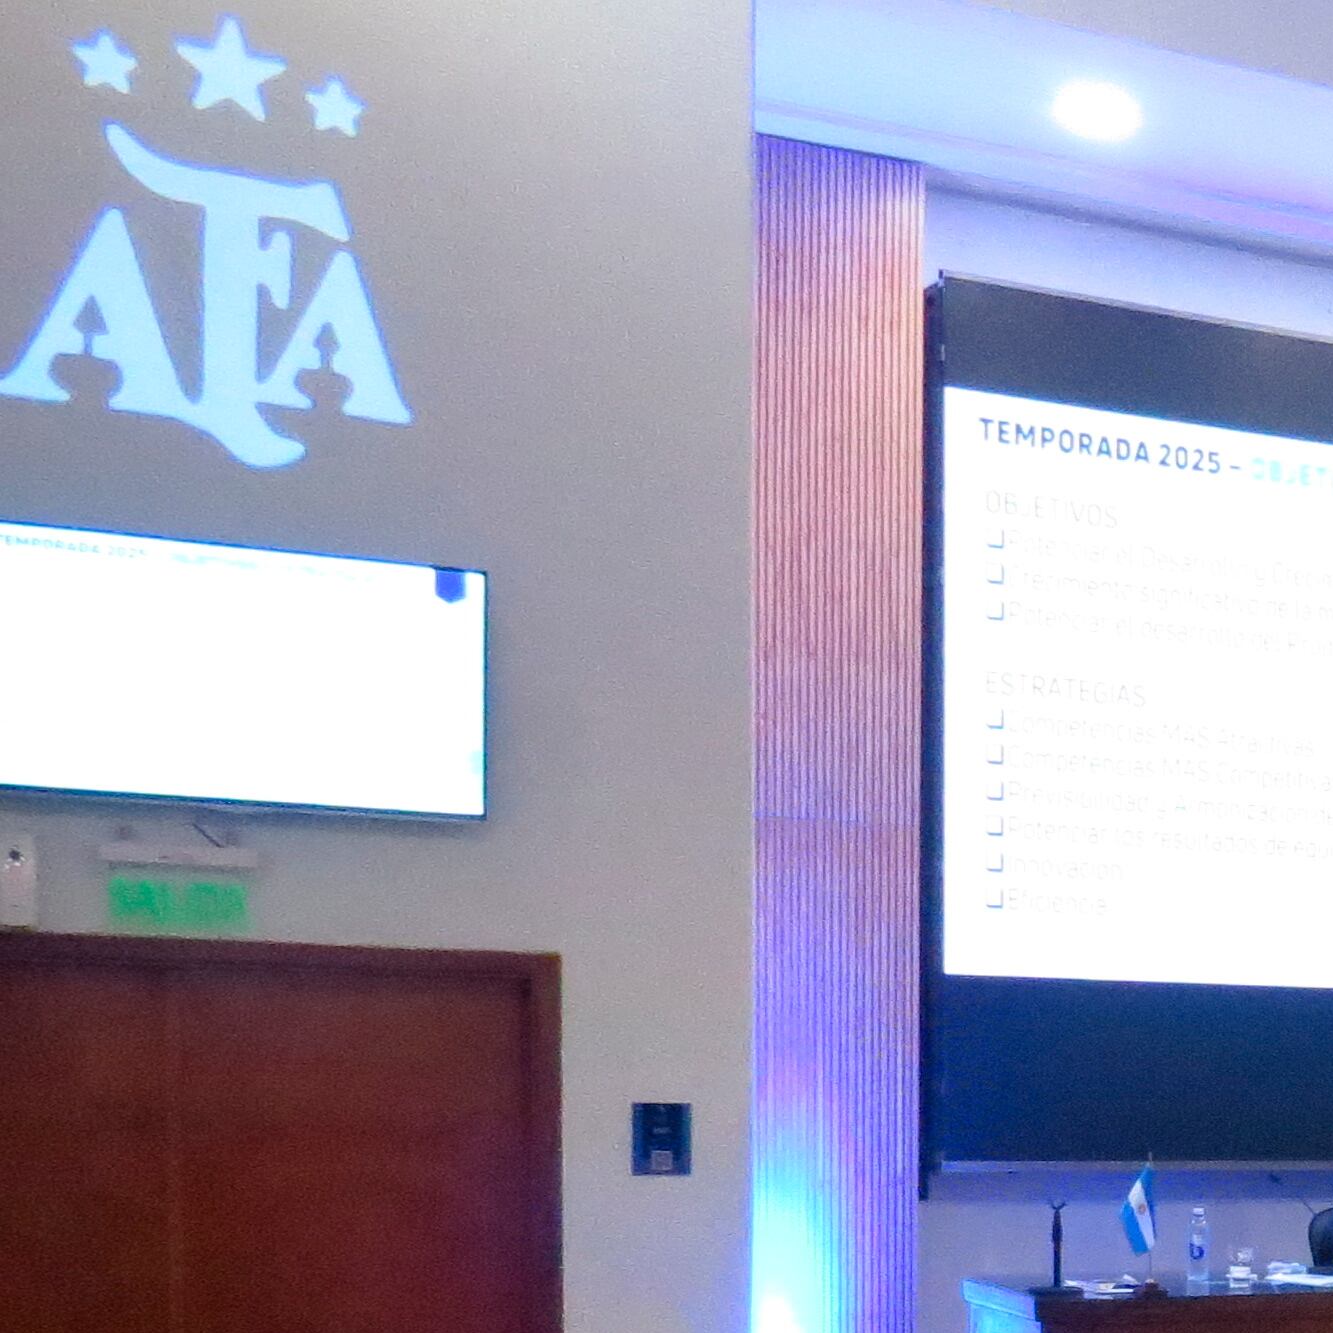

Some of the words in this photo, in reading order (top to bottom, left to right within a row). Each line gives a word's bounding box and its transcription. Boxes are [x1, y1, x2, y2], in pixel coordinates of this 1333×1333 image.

[0, 120, 414, 469] AFA
[979, 416, 1151, 464] TEMPORADA
[1158, 443, 1221, 475] 2025
[985, 671, 1147, 708] ESTRATEGIAS
